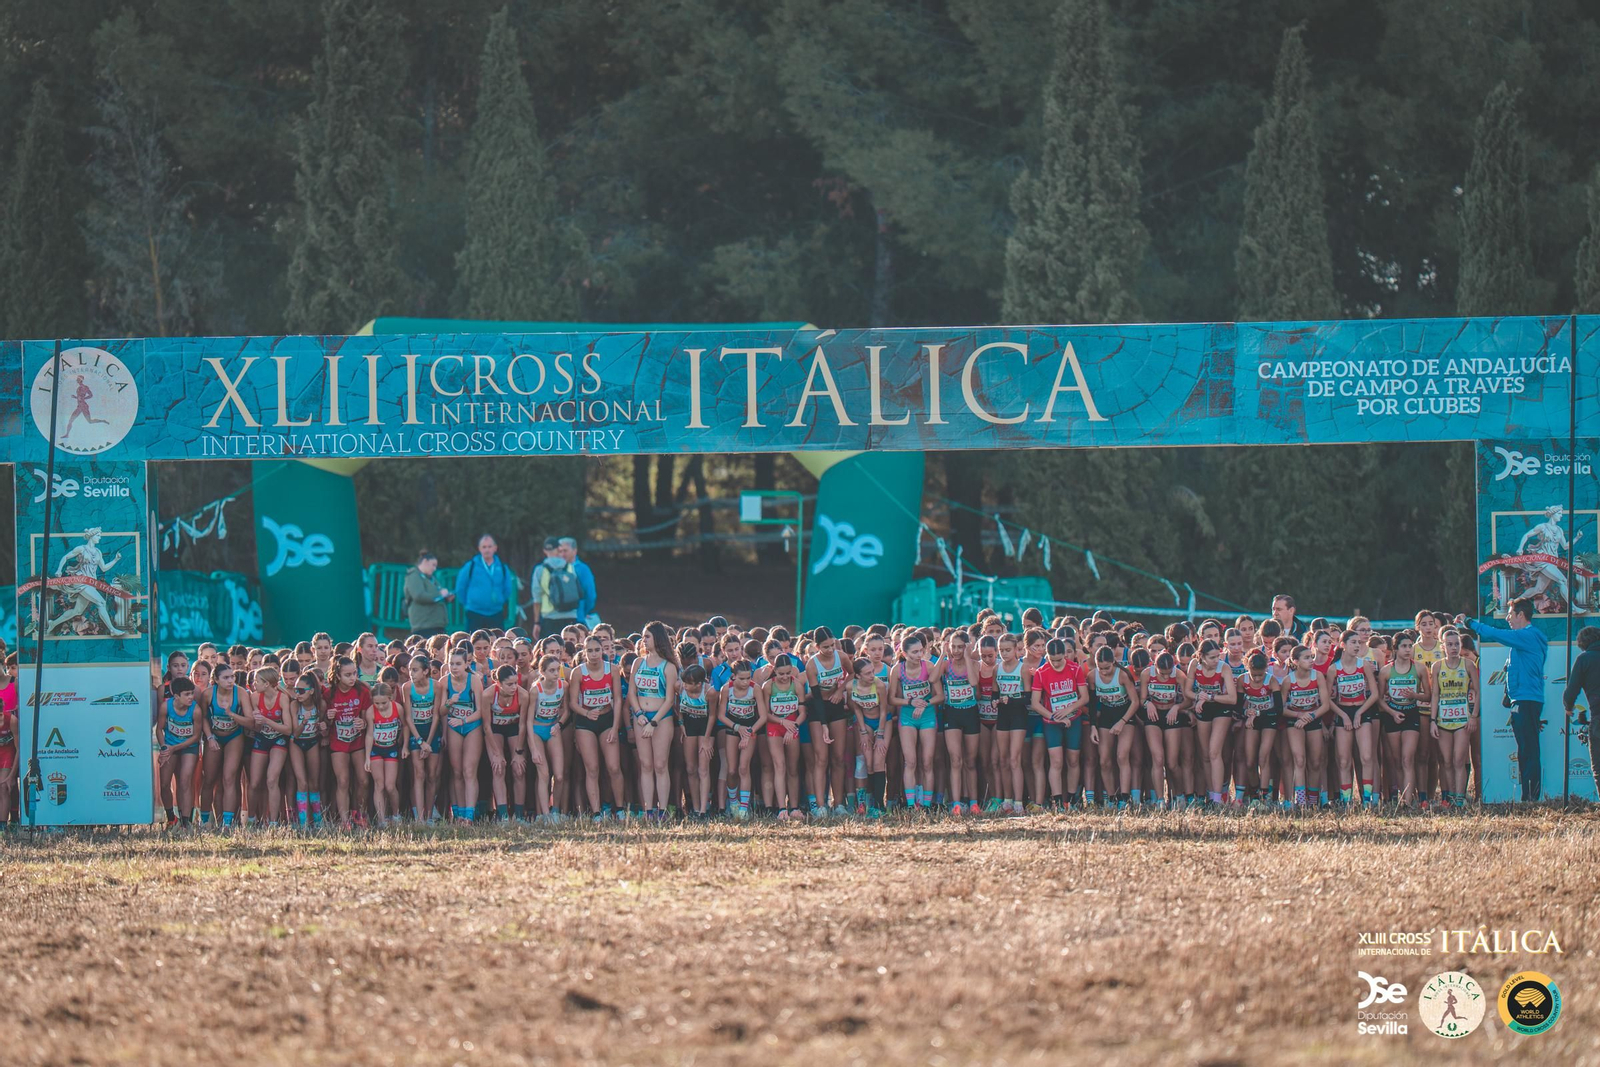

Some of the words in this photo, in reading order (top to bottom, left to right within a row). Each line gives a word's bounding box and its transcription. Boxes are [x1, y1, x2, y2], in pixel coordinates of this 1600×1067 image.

[1258, 359, 1409, 379] CAMPEONATO
[1413, 358, 1440, 376] DE
[1444, 353, 1572, 375] ANDALUCÍA
[39, 353, 128, 393] ITÁLICA
[430, 352, 602, 396] CROSS
[684, 329, 1109, 429] ITÁLICA
[202, 354, 425, 428] XLIII
[1308, 380, 1335, 397] DE
[1339, 378, 1418, 397] CAMPO
[1423, 378, 1440, 395] A
[1445, 374, 1525, 394] TRAVÉS
[430, 399, 667, 425] INTERNACIONAL
[1357, 399, 1399, 416] POR
[1404, 397, 1481, 416] CLUBES
[201, 433, 411, 456] INTERNATIONAL
[417, 432, 496, 453] CROSS
[501, 429, 625, 452] COUNTRY
[1544, 453, 1591, 463] Diputaión
[1544, 464, 1591, 475] Sevlla
[83, 475, 130, 485] Diputación
[83, 485, 130, 497] Sevilla
[637, 677, 657, 688] 7305
[1341, 682, 1364, 693] 7259
[907, 688, 930, 700] 5346
[950, 687, 972, 698] 5345
[586, 696, 609, 705] 7264
[1294, 697, 1316, 705] 7262
[731, 705, 753, 715] 7260
[773, 704, 797, 713] 7294
[980, 703, 998, 713] 368
[1442, 707, 1467, 717] 7361
[170, 724, 192, 735] 7398
[214, 719, 234, 729] 739
[376, 730, 397, 741] 7242
